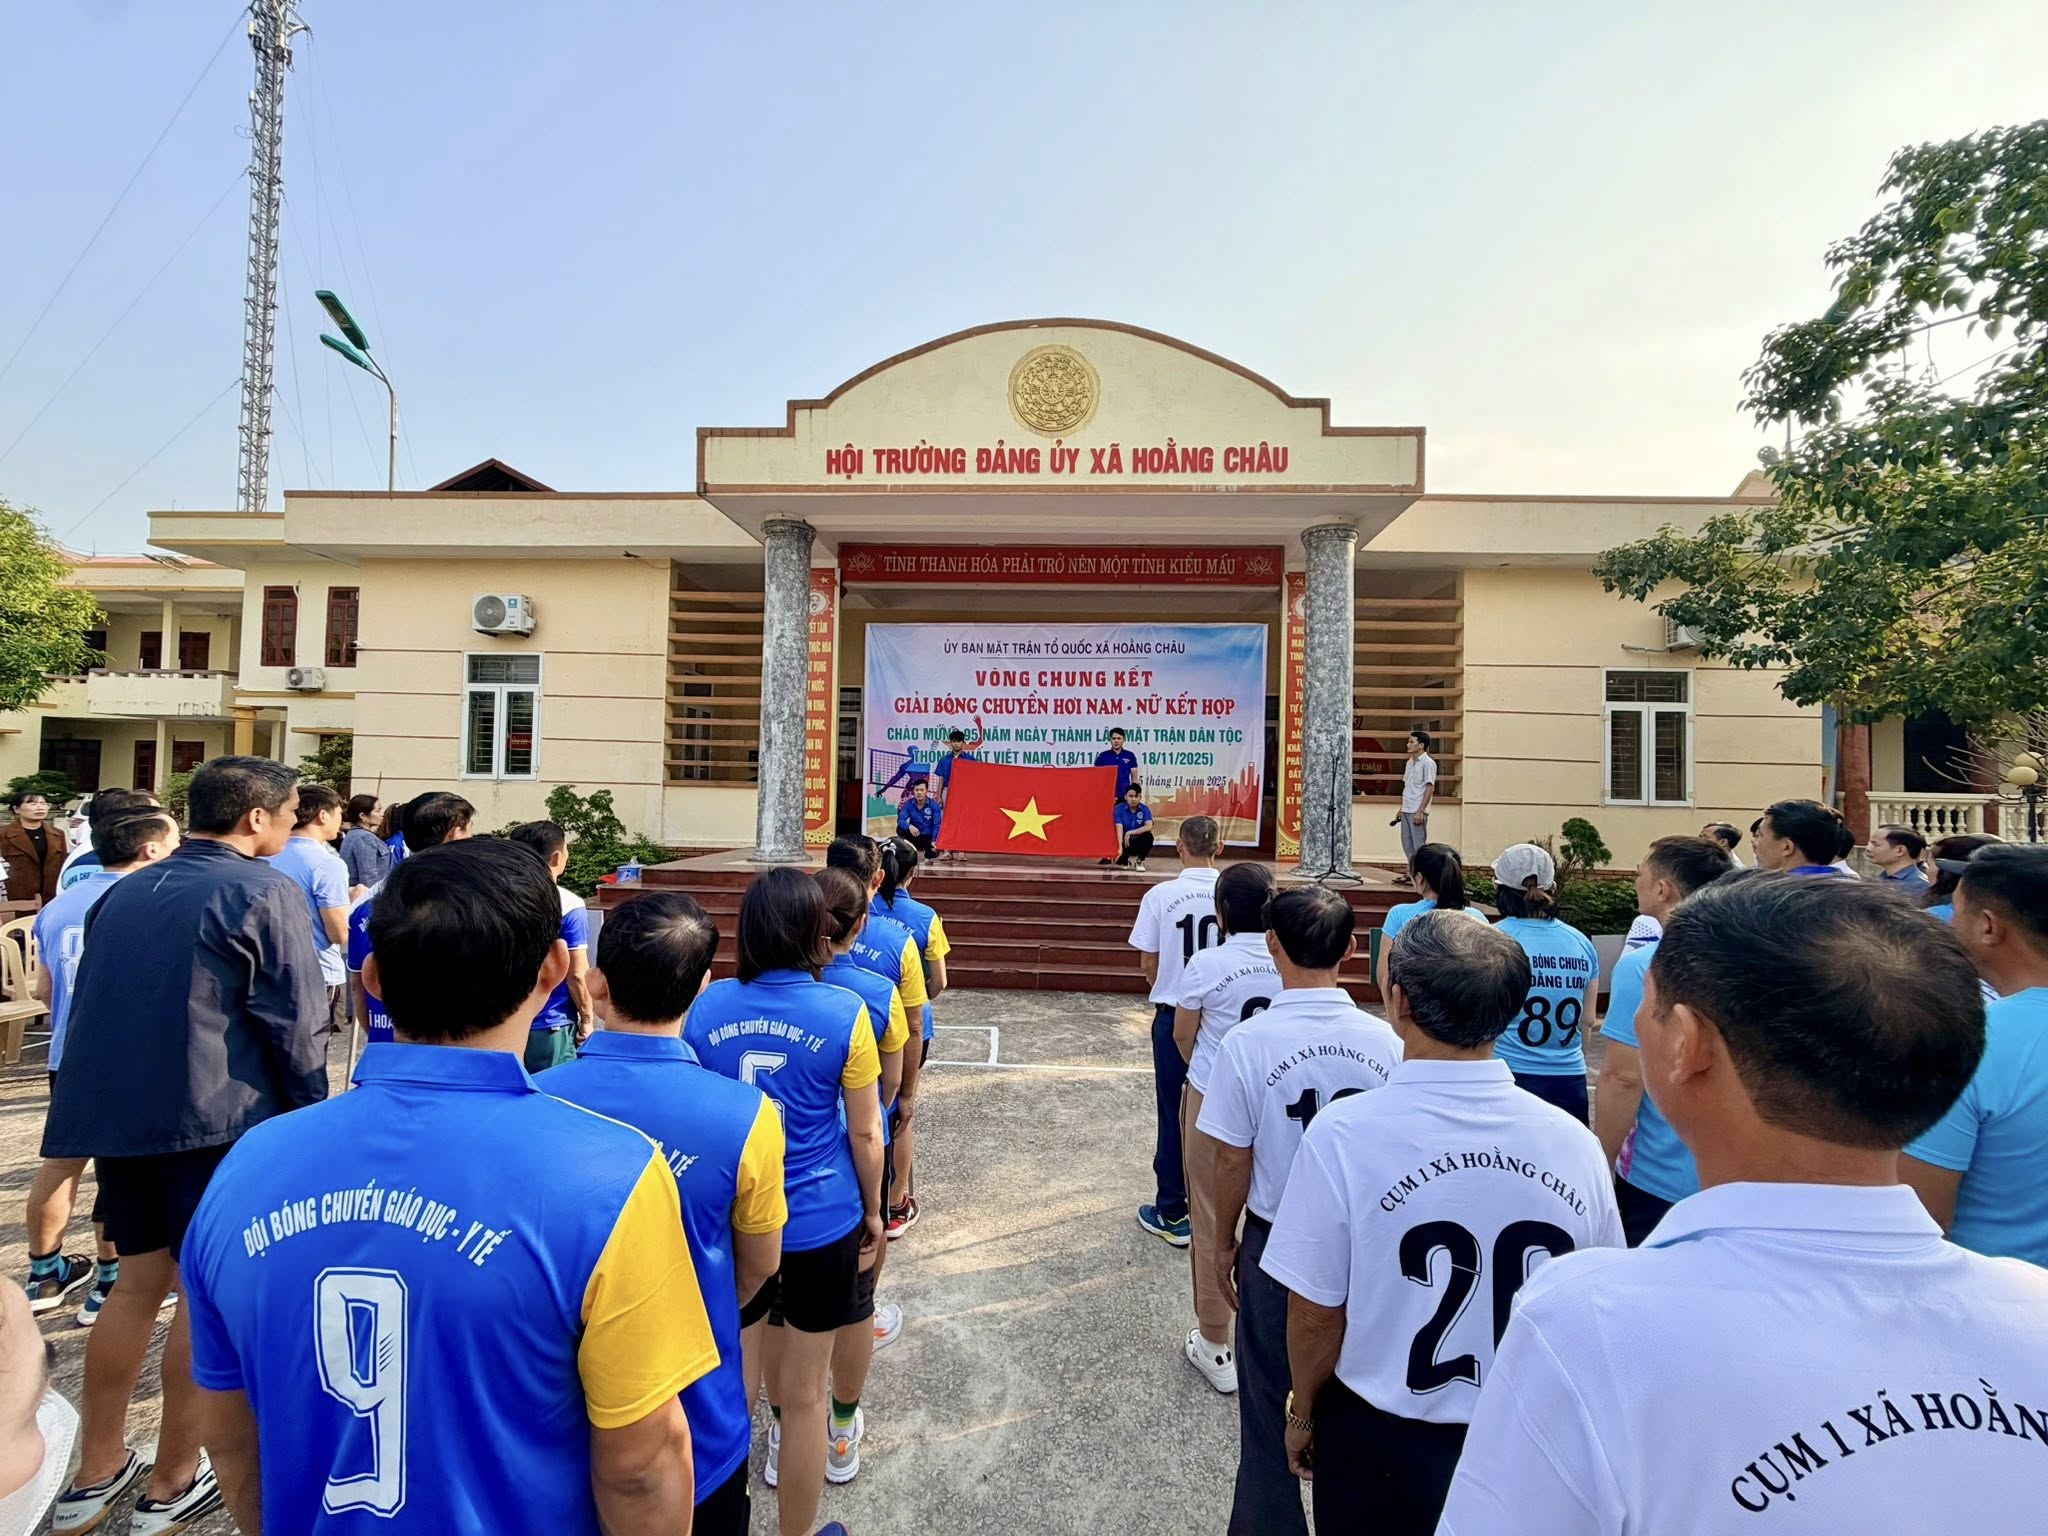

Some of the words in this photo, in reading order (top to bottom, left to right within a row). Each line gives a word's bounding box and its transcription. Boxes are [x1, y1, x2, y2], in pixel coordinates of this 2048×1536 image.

[826, 443, 863, 480] HỘI
[873, 439, 966, 474] TRƯỜNG
[976, 439, 1040, 474] ĐẢNG
[1050, 438, 1080, 474] ỦY
[1090, 442, 1123, 474] XÃ
[1132, 437, 1214, 474] HOẰNG
[1223, 441, 1289, 474] CHÂU
[920, 556, 968, 573] THANH
[971, 553, 999, 573] HÓA
[1002, 552, 1035, 574] PHẢI
[1038, 552, 1065, 574] TRỞ
[1068, 554, 1096, 574] NÊN
[1100, 554, 1129, 578] MỘT
[1132, 553, 1164, 575] TỈNH
[1169, 551, 1201, 575] KIỂU
[944, 639, 959, 653] ỦY
[962, 643, 984, 653] BAN
[987, 643, 1007, 657] MẶT
[1012, 641, 1041, 657] TRẬN
[1044, 637, 1058, 653] TỔ
[1062, 638, 1092, 655] QUỐC
[1096, 640, 1110, 654] XÃ
[1113, 638, 1151, 654] HOẰNG
[1155, 640, 1186, 654] CHÂU
[976, 668, 1030, 687] VÒNG
[1038, 671, 1107, 688] CHUNG
[1114, 665, 1153, 687] KẾT
[894, 690, 929, 713] GIẢI
[933, 692, 978, 714] BÓNG
[982, 690, 1048, 714] CHUYỀN
[1053, 698, 1082, 714] HƠI
[1086, 699, 1123, 715] NAM
[1136, 694, 1162, 715] NỮ
[1165, 691, 1197, 715] KẾT
[1201, 698, 1236, 720] HỢP
[887, 725, 919, 740] CHÀO
[923, 724, 957, 740] MỪN
[965, 729, 979, 740] 95
[982, 726, 1011, 741] NĂM
[1015, 726, 1048, 741] NGÀY
[1052, 726, 1092, 742] THÀNH
[1096, 727, 1110, 745] LẬ
[1124, 729, 1150, 745] MẶT
[1154, 727, 1185, 745] TRẬN
[1189, 728, 1215, 743] DÂN
[1219, 728, 1242, 746] TỘC
[994, 748, 1020, 764] VIỆT
[1027, 751, 1052, 764] NAM
[1142, 751, 1214, 766] 18/11/2025)
[1146, 774, 1172, 788] tháng
[1185, 776, 1205, 787] năm
[1207, 776, 1227, 787] 2025
[1176, 913, 1227, 969] 10
[1532, 953, 1557, 969] BÓNG
[720, 1023, 739, 1041] BÓNG
[769, 1019, 788, 1038] GIÁO
[786, 1025, 804, 1043] DỤC
[805, 1034, 815, 1048] Y
[810, 1037, 828, 1053] TẾ
[1517, 995, 1582, 1048] 89
[1266, 1060, 1292, 1087] CỤM
[1297, 1045, 1317, 1062] XÃ
[1318, 1041, 1366, 1063] HOẰNG
[672, 1154, 700, 1179] TẾ
[1380, 1174, 1420, 1212] CỤM
[1417, 1167, 1430, 1183] 1
[1429, 1152, 1459, 1178] XÃ
[1462, 1145, 1537, 1179] HOẰNG
[1540, 1171, 1588, 1217] CHÂU
[269, 1199, 318, 1242] BÓNG
[383, 1186, 424, 1230] GIÁO
[415, 1199, 458, 1244] DỤC
[242, 1215, 271, 1259] ĐỘI
[456, 1220, 485, 1253] Y
[467, 1229, 513, 1267] TẾ
[1399, 1219, 1576, 1396] 20
[313, 1266, 409, 1518] 9
[1731, 1431, 1829, 1513] CỤM
[1820, 1420, 1856, 1458] 1
[1846, 1387, 1915, 1447] XÃ
[1911, 1377, 2048, 1448] HOẰN
